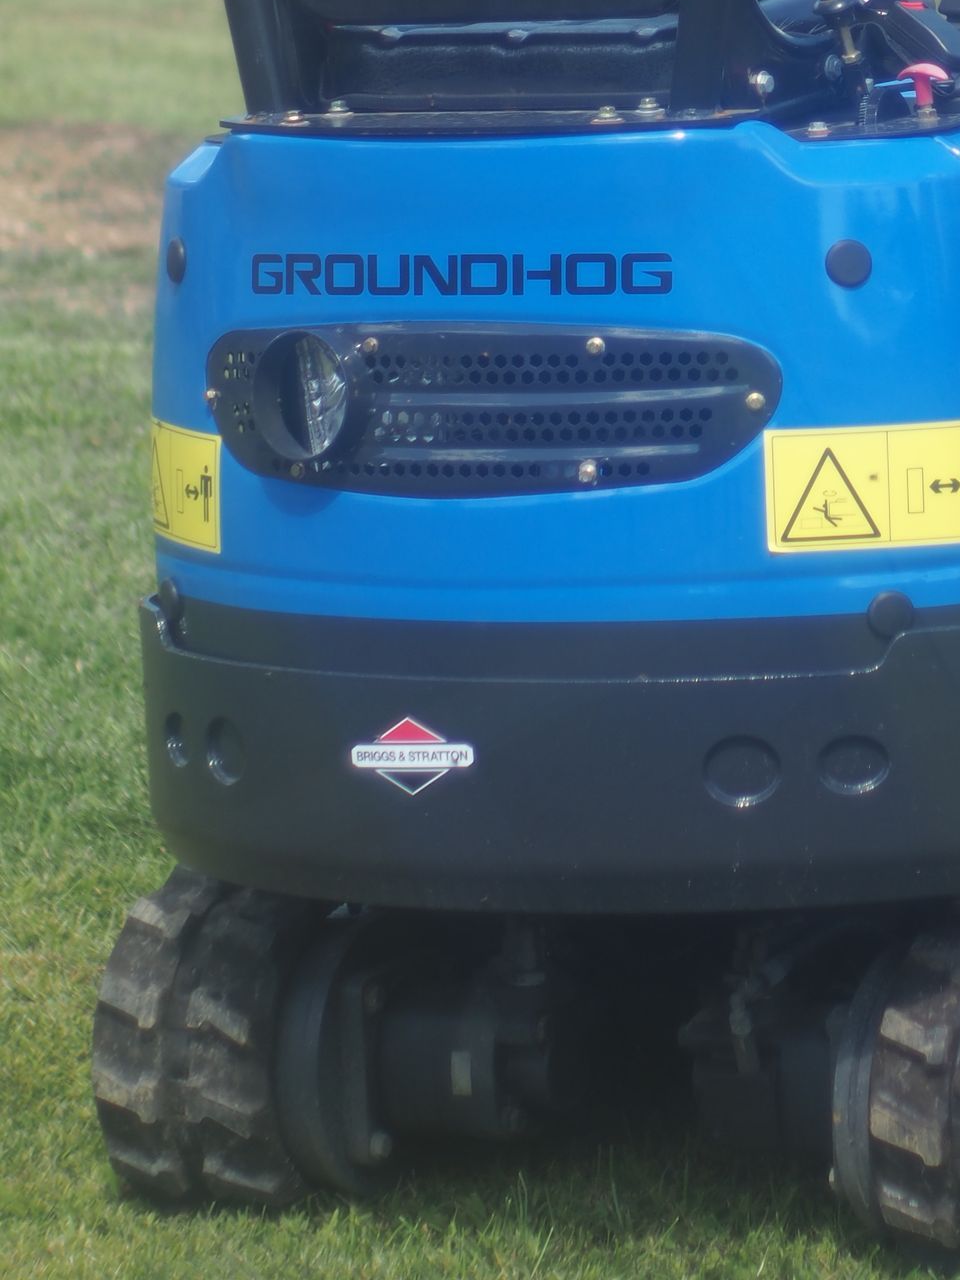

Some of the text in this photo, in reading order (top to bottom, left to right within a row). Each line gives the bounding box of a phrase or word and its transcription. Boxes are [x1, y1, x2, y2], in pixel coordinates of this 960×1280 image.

[251, 252, 673, 296] GROUNDHOG
[356, 750, 468, 762] BRIGGS & STRATTON
